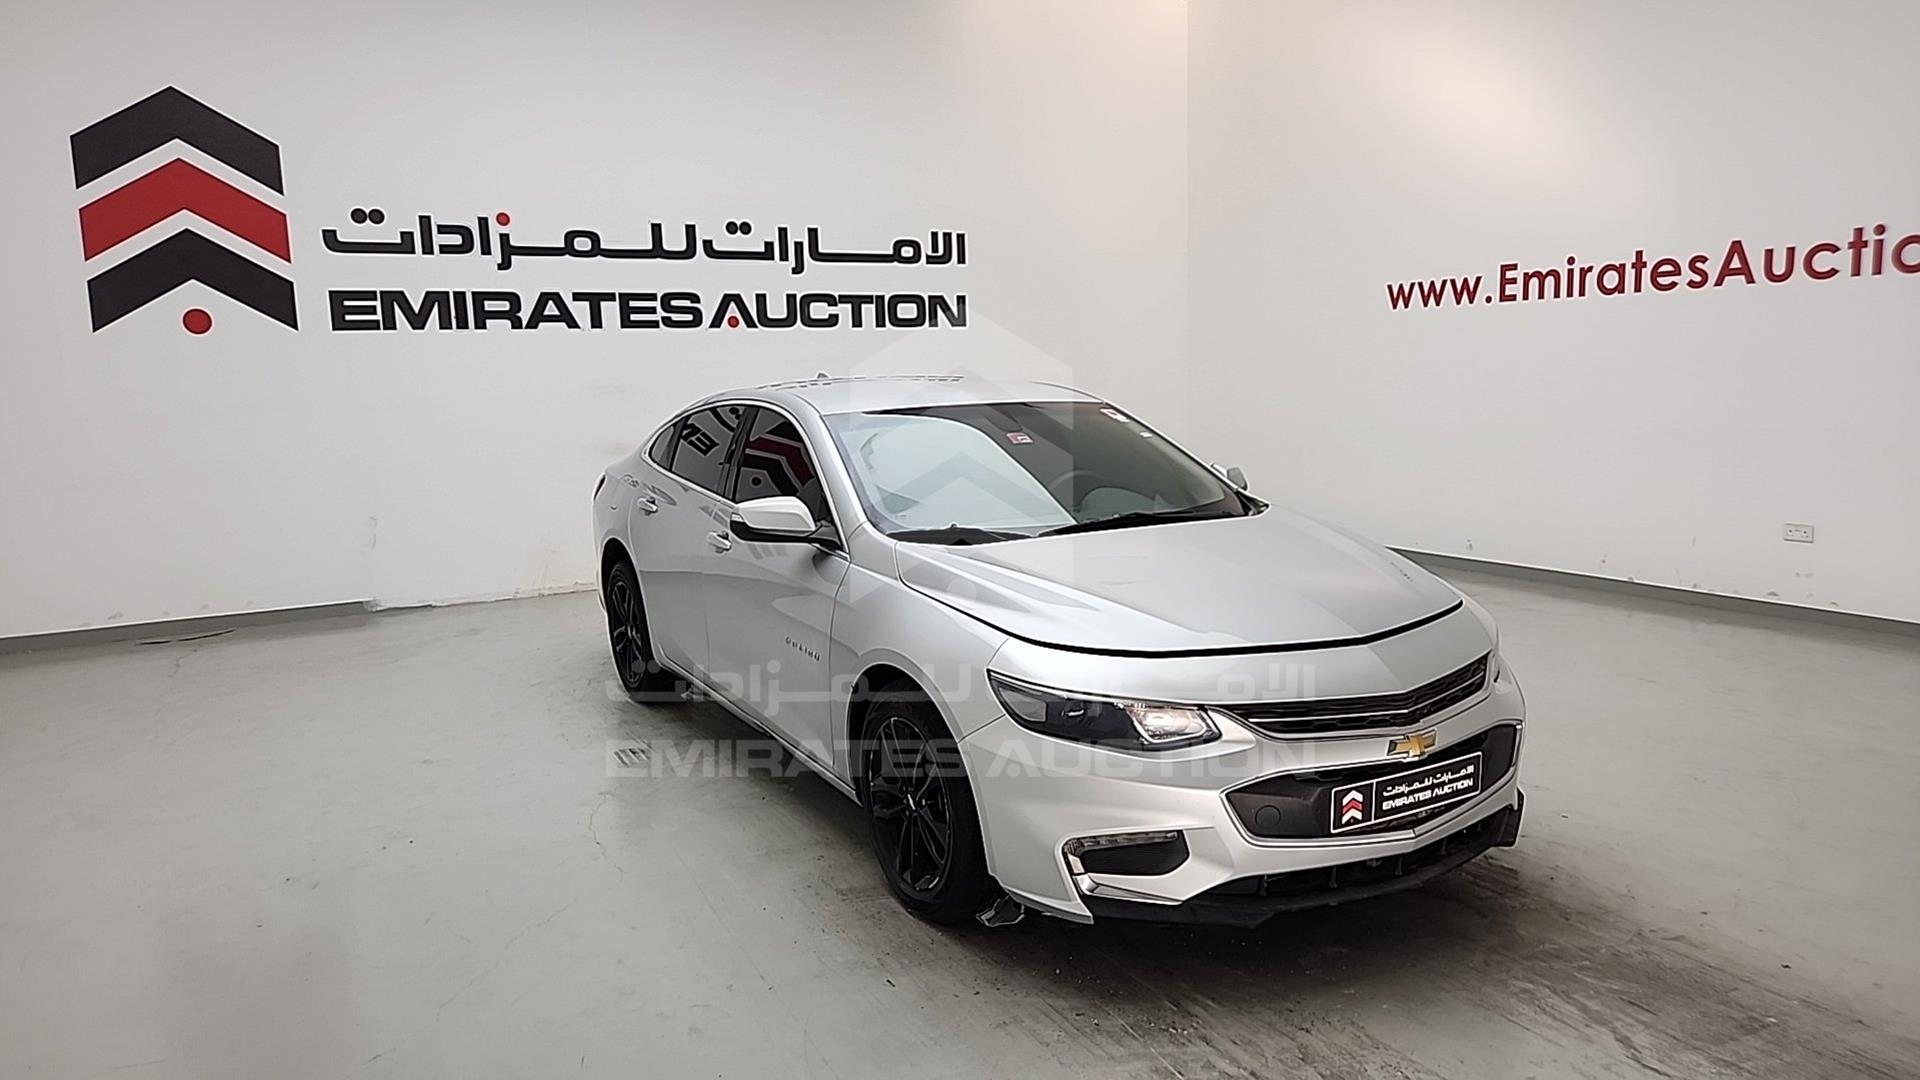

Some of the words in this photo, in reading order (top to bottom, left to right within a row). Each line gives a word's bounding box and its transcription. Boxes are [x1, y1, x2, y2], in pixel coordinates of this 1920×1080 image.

[328, 290, 705, 332] EMIRATES
[707, 292, 967, 330] AUCTION
[1382, 790, 1432, 810] EMIRATES
[1433, 778, 1473, 797] AUCTION
